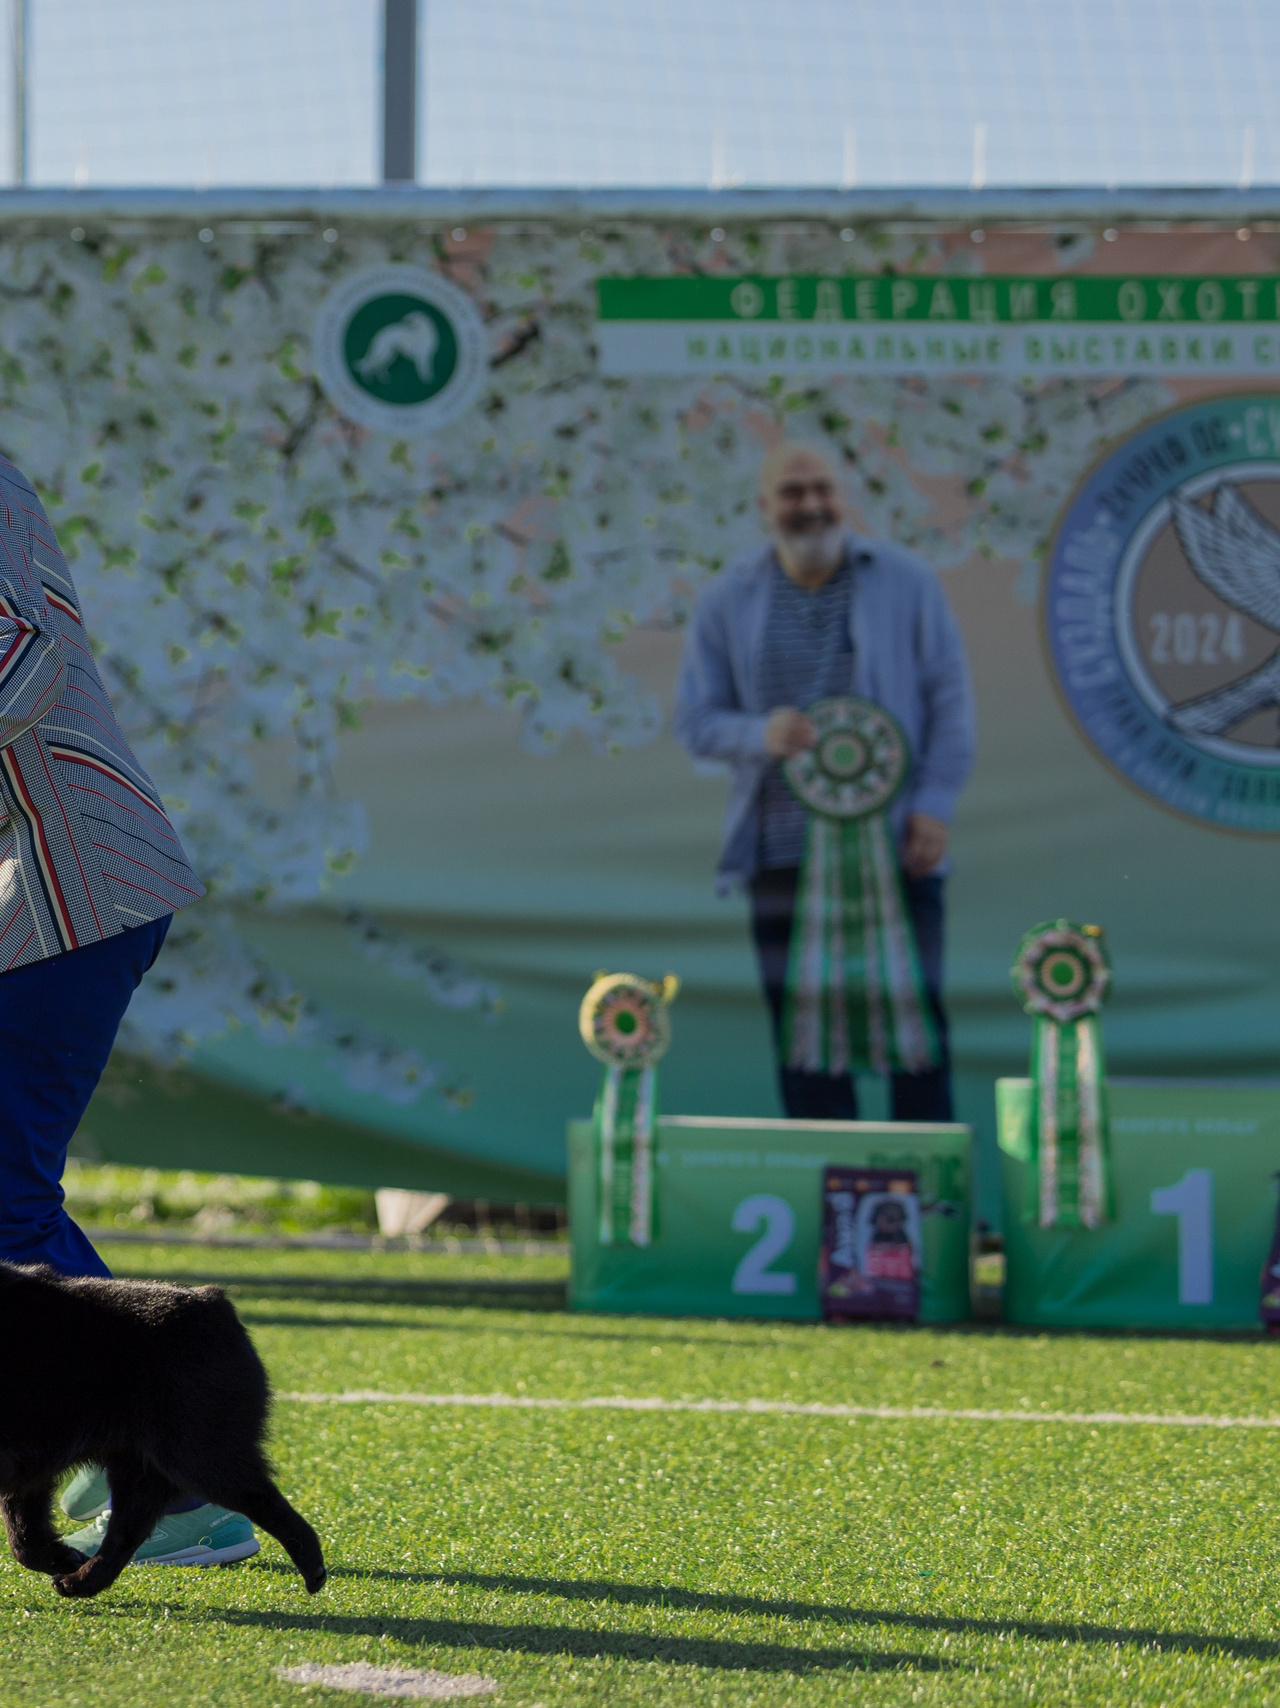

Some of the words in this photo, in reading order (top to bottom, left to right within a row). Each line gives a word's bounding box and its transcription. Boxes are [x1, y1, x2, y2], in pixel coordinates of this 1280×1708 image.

[729, 280, 1078, 322] ФЕДЕРАЦИЯ
[1117, 281, 1280, 322] ОХОТ
[686, 333, 1002, 364] НАЦИОНАЛЬНЫЕ
[1024, 334, 1236, 365] ВЫСТАВКИ
[1148, 611, 1246, 667] 2024
[730, 1194, 797, 1295] 2
[1151, 1168, 1214, 1305] 1
